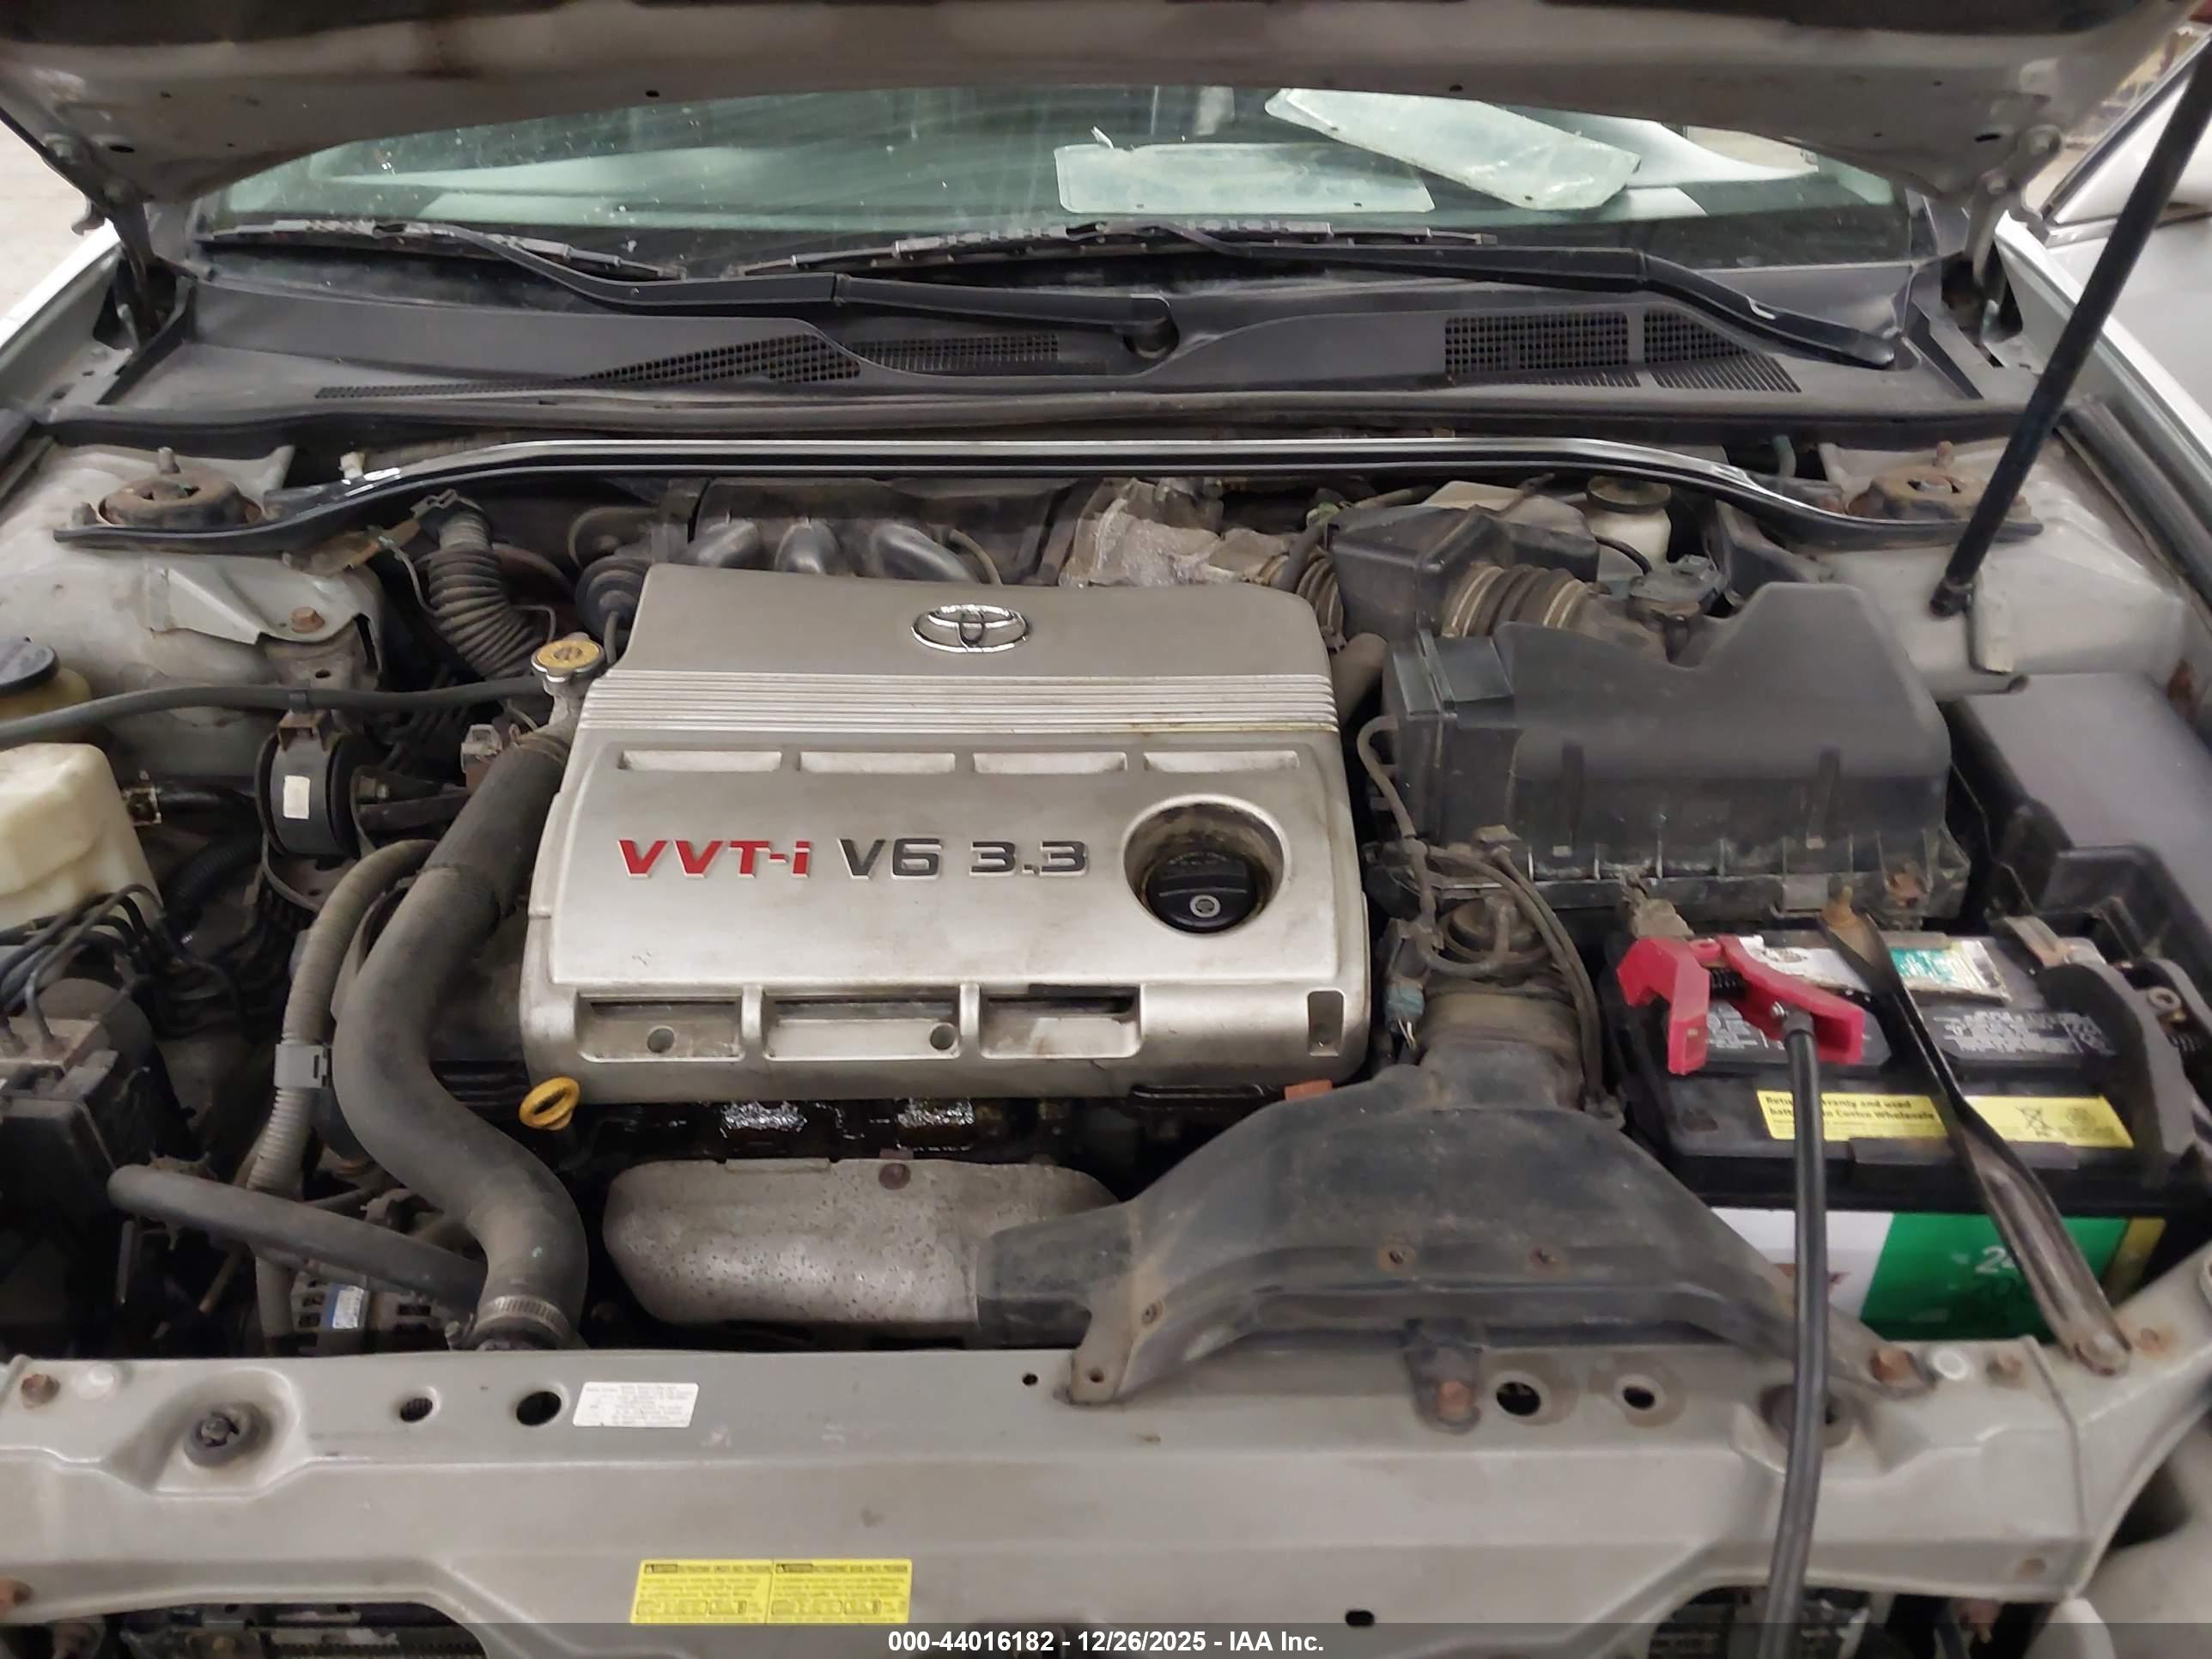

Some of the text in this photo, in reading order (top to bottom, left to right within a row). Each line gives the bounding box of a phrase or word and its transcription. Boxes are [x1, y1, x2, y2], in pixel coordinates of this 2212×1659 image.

[617, 837, 1089, 879] VVT-i V6 3.3
